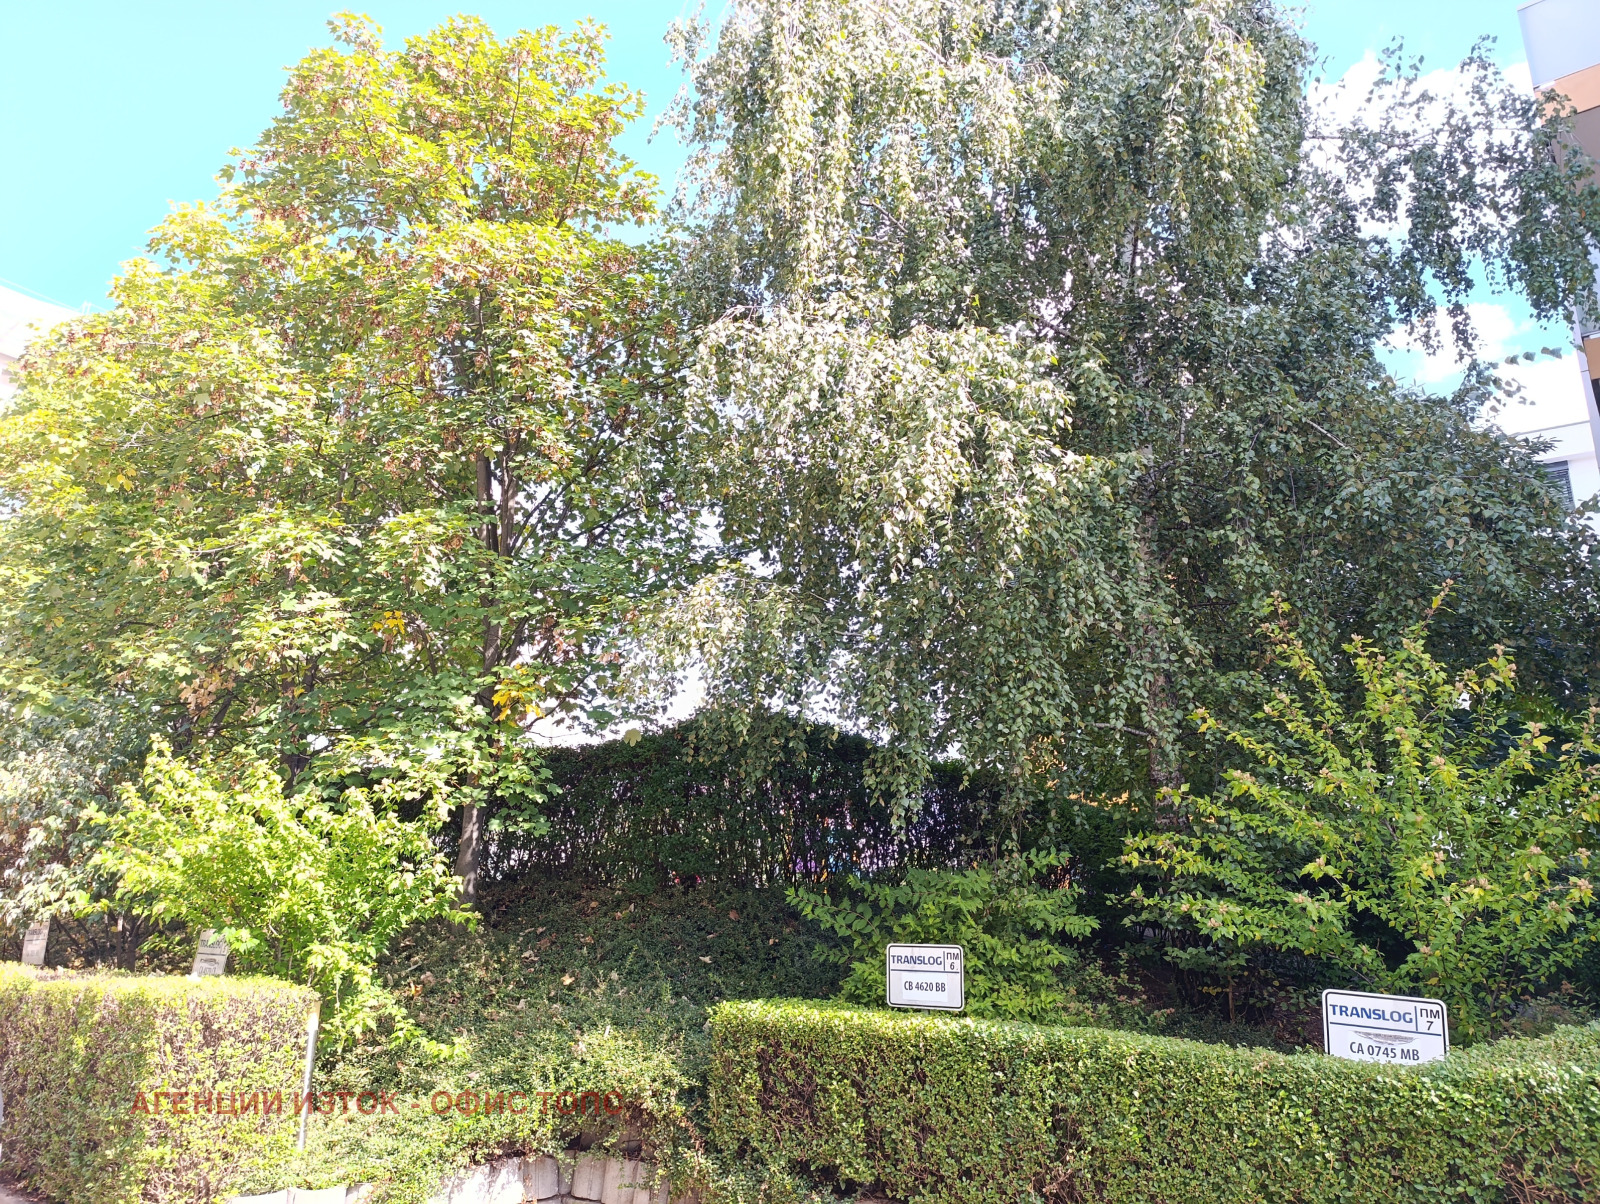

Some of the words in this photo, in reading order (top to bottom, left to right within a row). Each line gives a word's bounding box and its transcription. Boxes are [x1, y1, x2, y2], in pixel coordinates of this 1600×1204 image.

[891, 954, 942, 966] TRANSLOG
[946, 952, 960, 961] ПМ
[950, 961, 955, 971] 6
[915, 981, 934, 992] 4620
[1329, 1003, 1413, 1024] TRANSLOG
[1420, 1008, 1440, 1019] ПМ
[1426, 1020, 1434, 1031] 7
[1349, 1041, 1365, 1055] CA
[1367, 1044, 1397, 1059] 0745
[1400, 1048, 1420, 1062] MB
